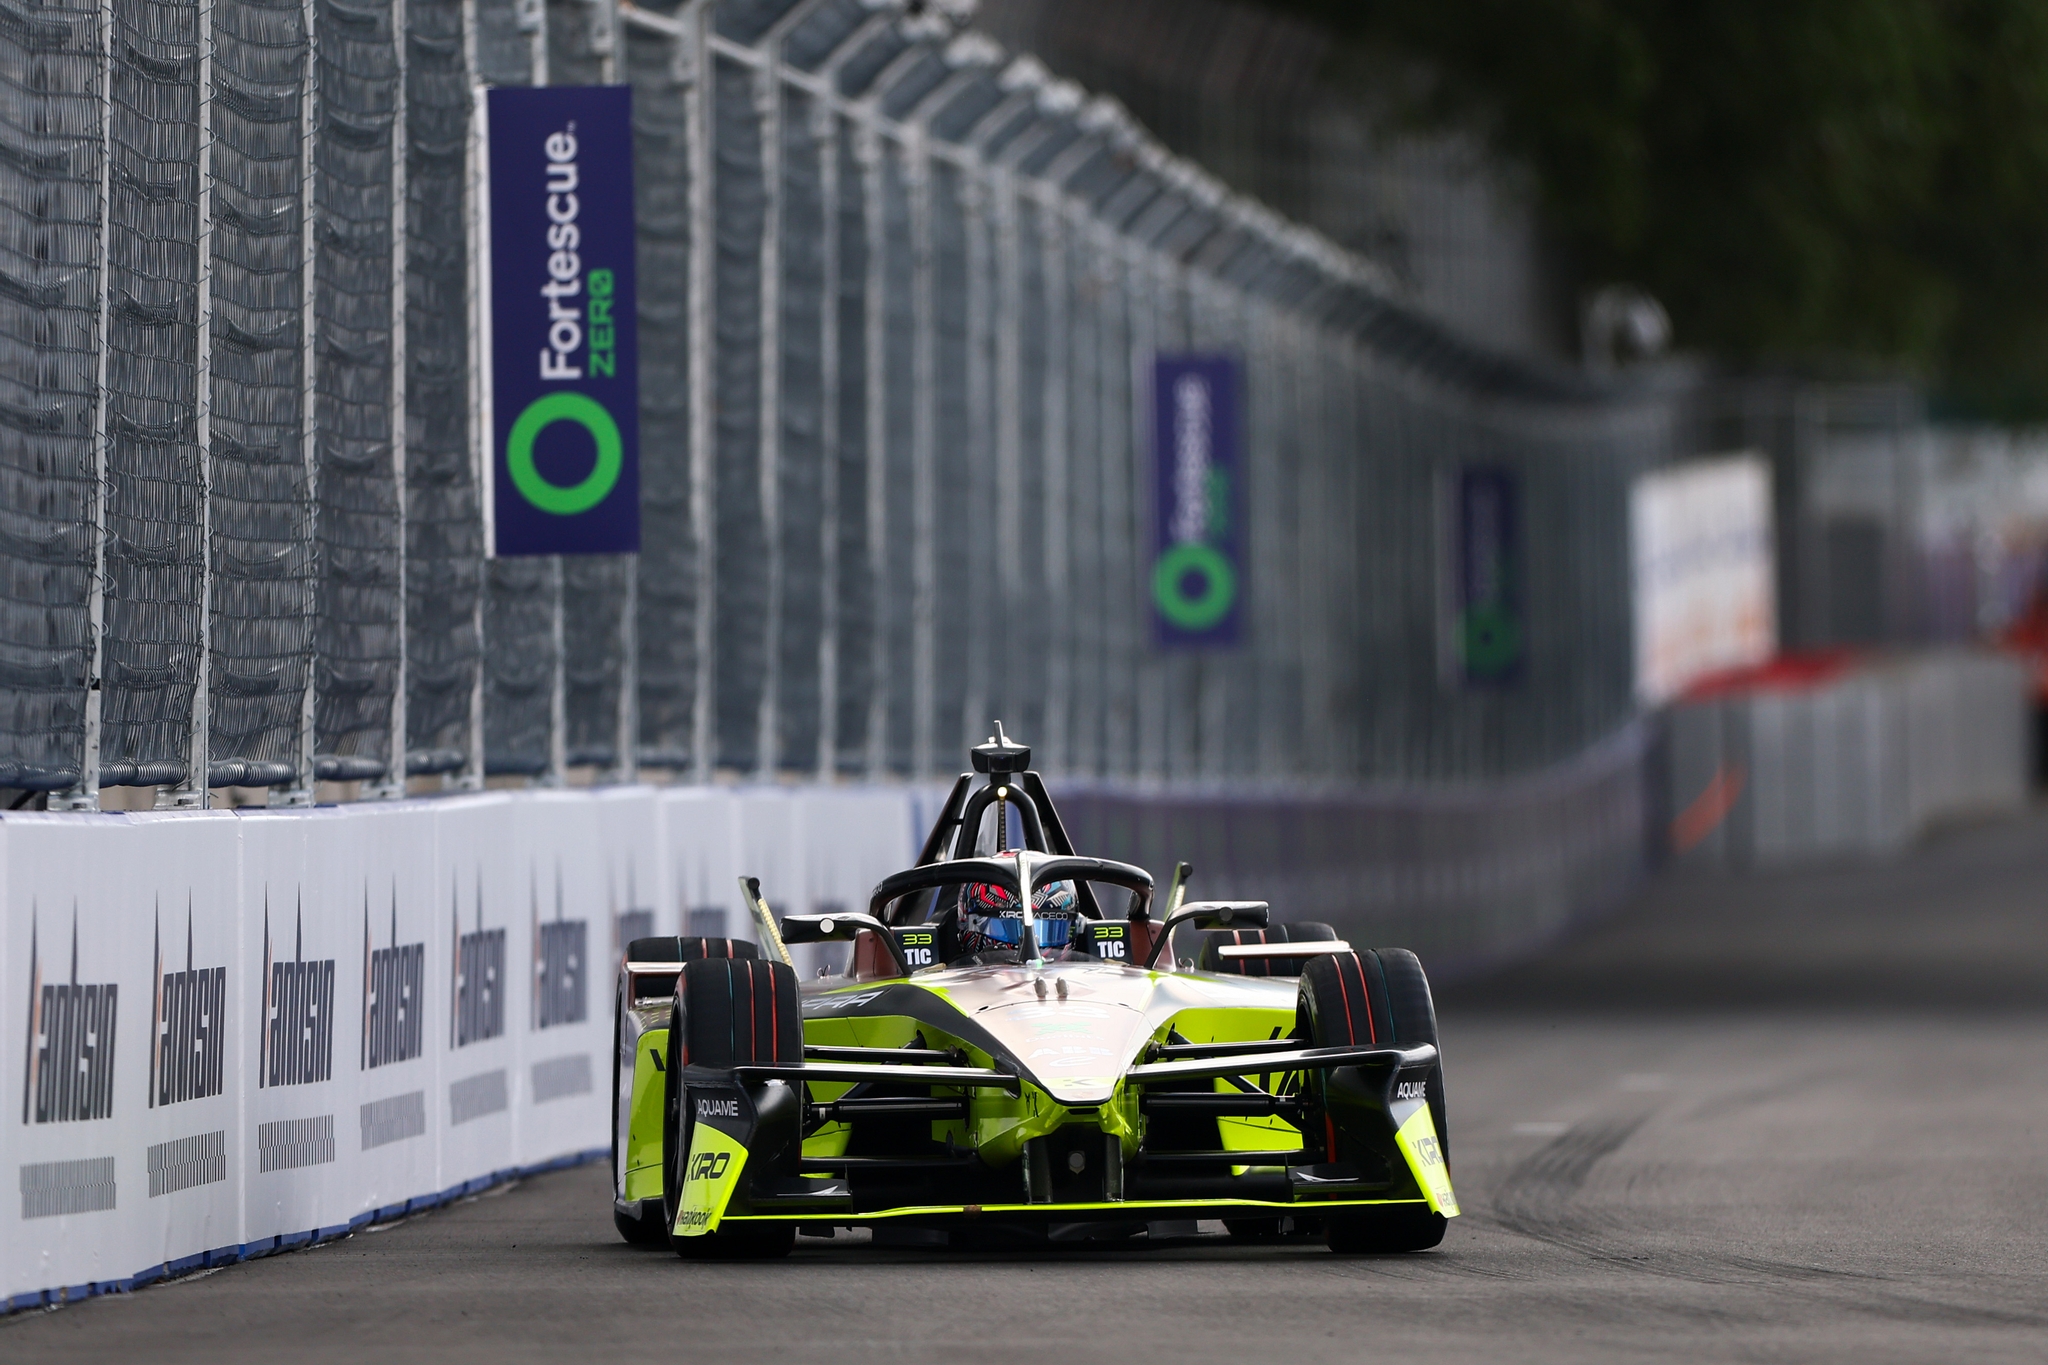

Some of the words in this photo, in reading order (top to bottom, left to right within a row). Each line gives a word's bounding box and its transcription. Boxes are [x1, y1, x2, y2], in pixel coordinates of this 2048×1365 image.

[902, 933, 932, 945] 33
[1093, 926, 1124, 939] 33
[904, 948, 932, 965] TIC
[1097, 940, 1125, 958] TIC
[686, 1152, 731, 1182] KIRO
